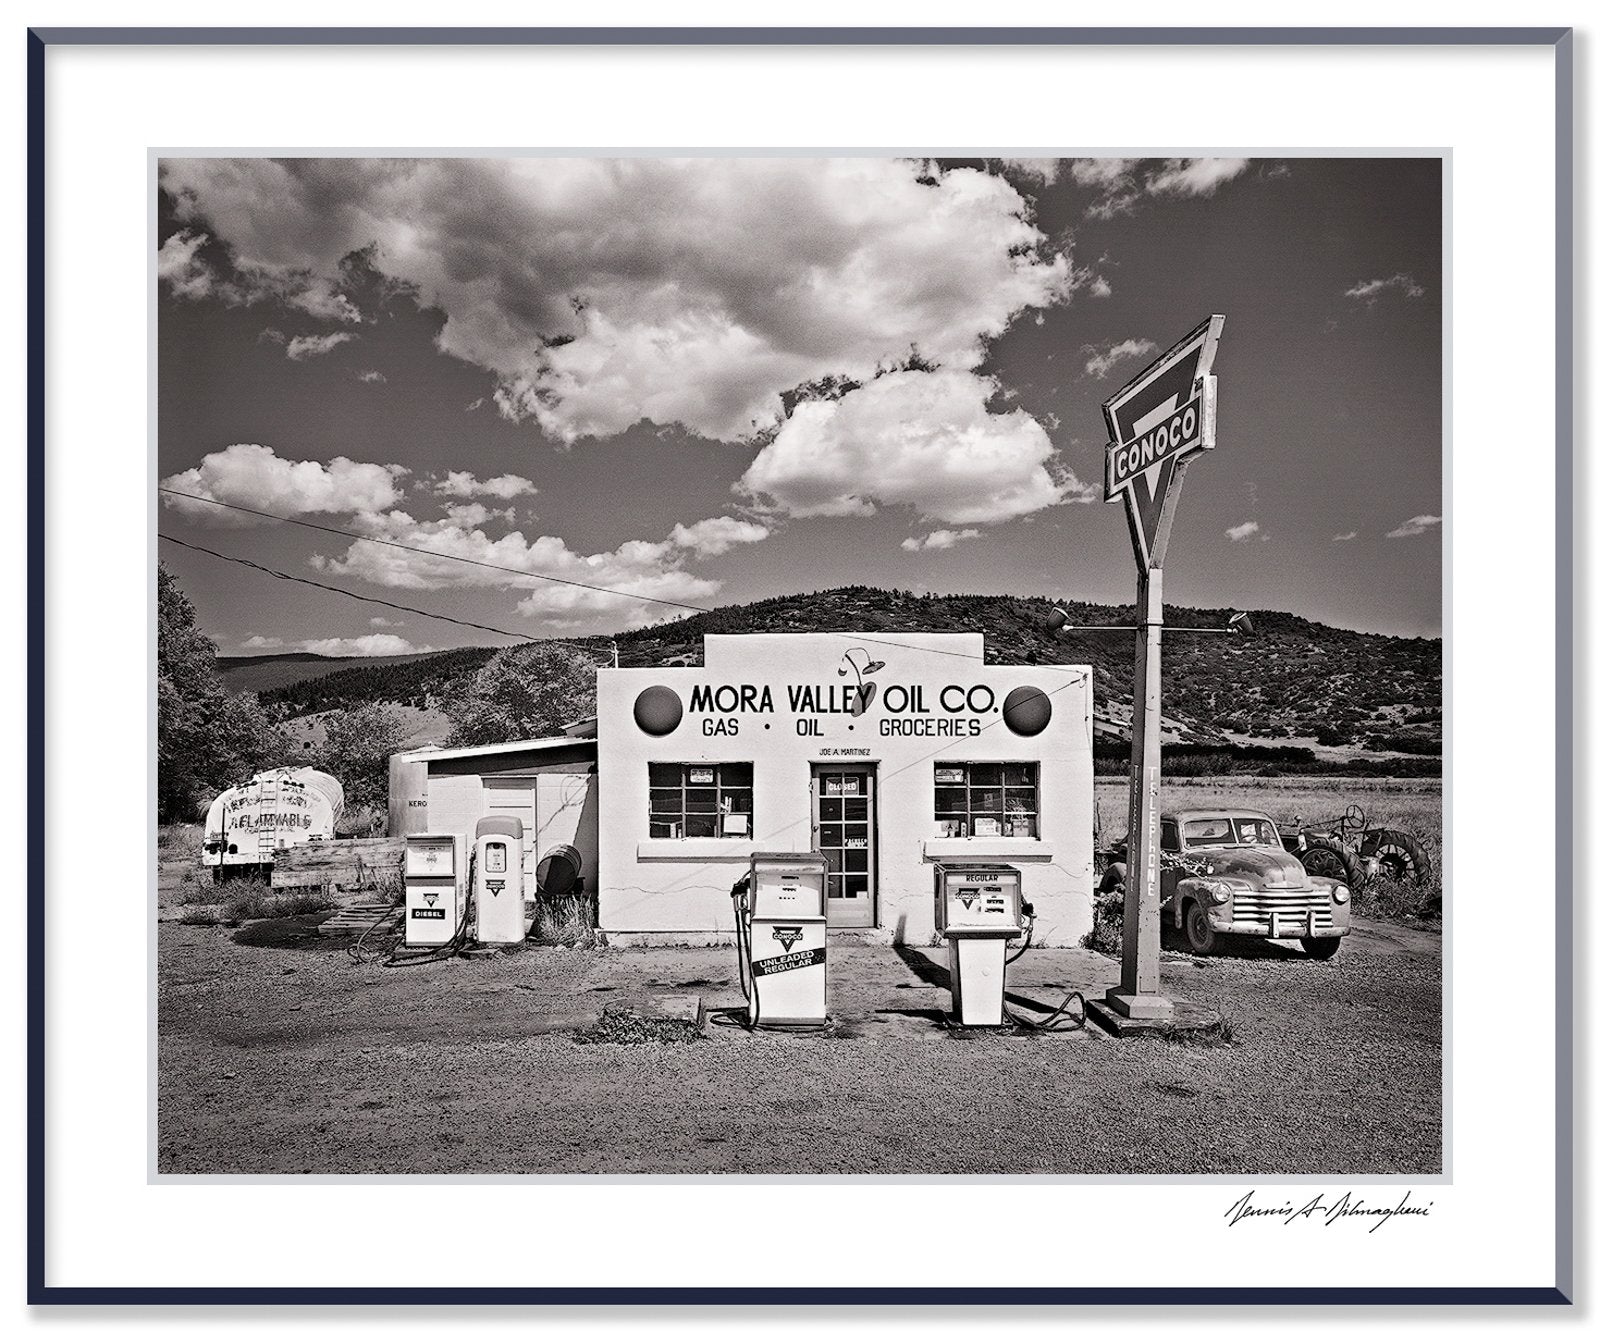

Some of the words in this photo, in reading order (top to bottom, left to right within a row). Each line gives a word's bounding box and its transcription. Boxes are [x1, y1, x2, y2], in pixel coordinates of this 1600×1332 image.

[1117, 407, 1196, 480] CONOCO
[688, 684, 774, 714] MORA
[787, 684, 870, 714] VALLEY
[883, 684, 930, 714] OIL
[939, 684, 999, 714] CO.
[702, 718, 739, 737] GAS
[796, 718, 824, 737] OIL
[879, 718, 981, 737] GROCERIES
[819, 748, 831, 756] JOE
[840, 748, 871, 756] MARTINEZ
[828, 782, 857, 791] CLOSED
[965, 874, 999, 882] REGULAR
[415, 910, 443, 918] DIESEL
[759, 950, 814, 968] UNLEADED
[764, 958, 812, 974] REGULAR
